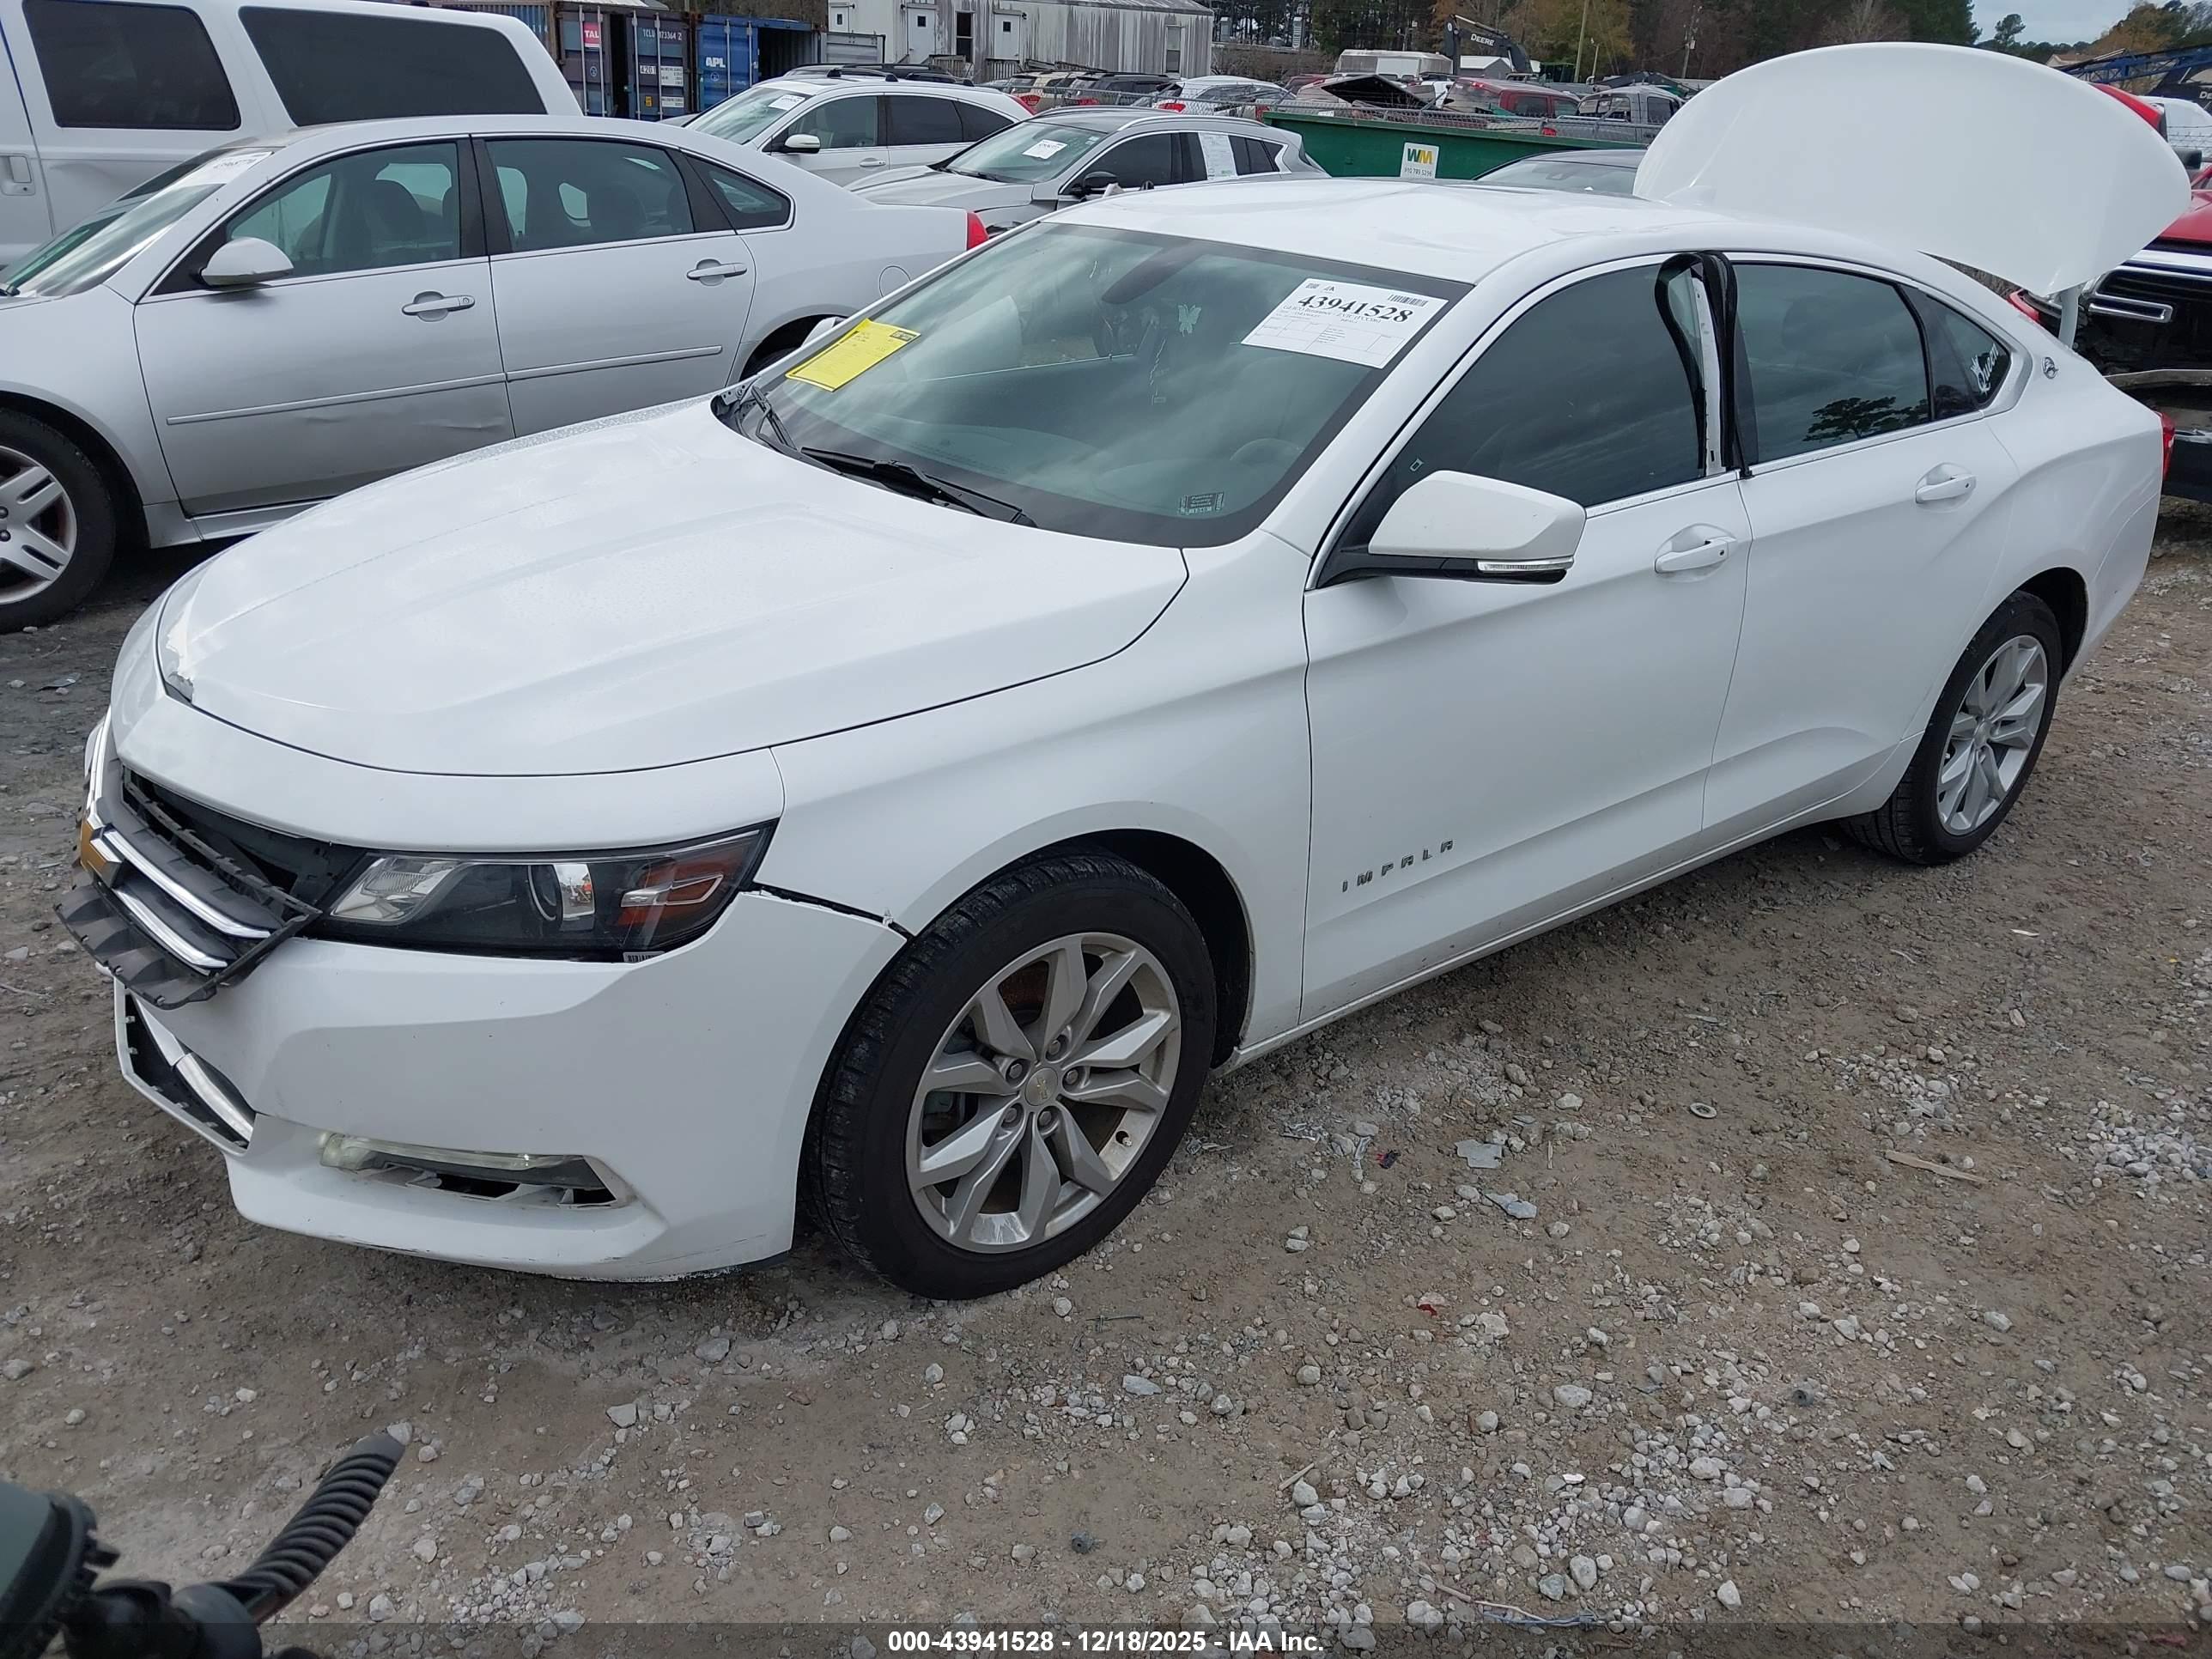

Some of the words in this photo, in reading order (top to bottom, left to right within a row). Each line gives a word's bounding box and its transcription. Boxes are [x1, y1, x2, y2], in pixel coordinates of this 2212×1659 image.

[584, 30, 599, 39] TAL
[1470, 33, 1495, 46] DEERE
[706, 57, 726, 68] APL
[1407, 148, 1432, 165] WM
[1298, 295, 1413, 323] 43941528
[1341, 840, 1454, 893] IMPALA
